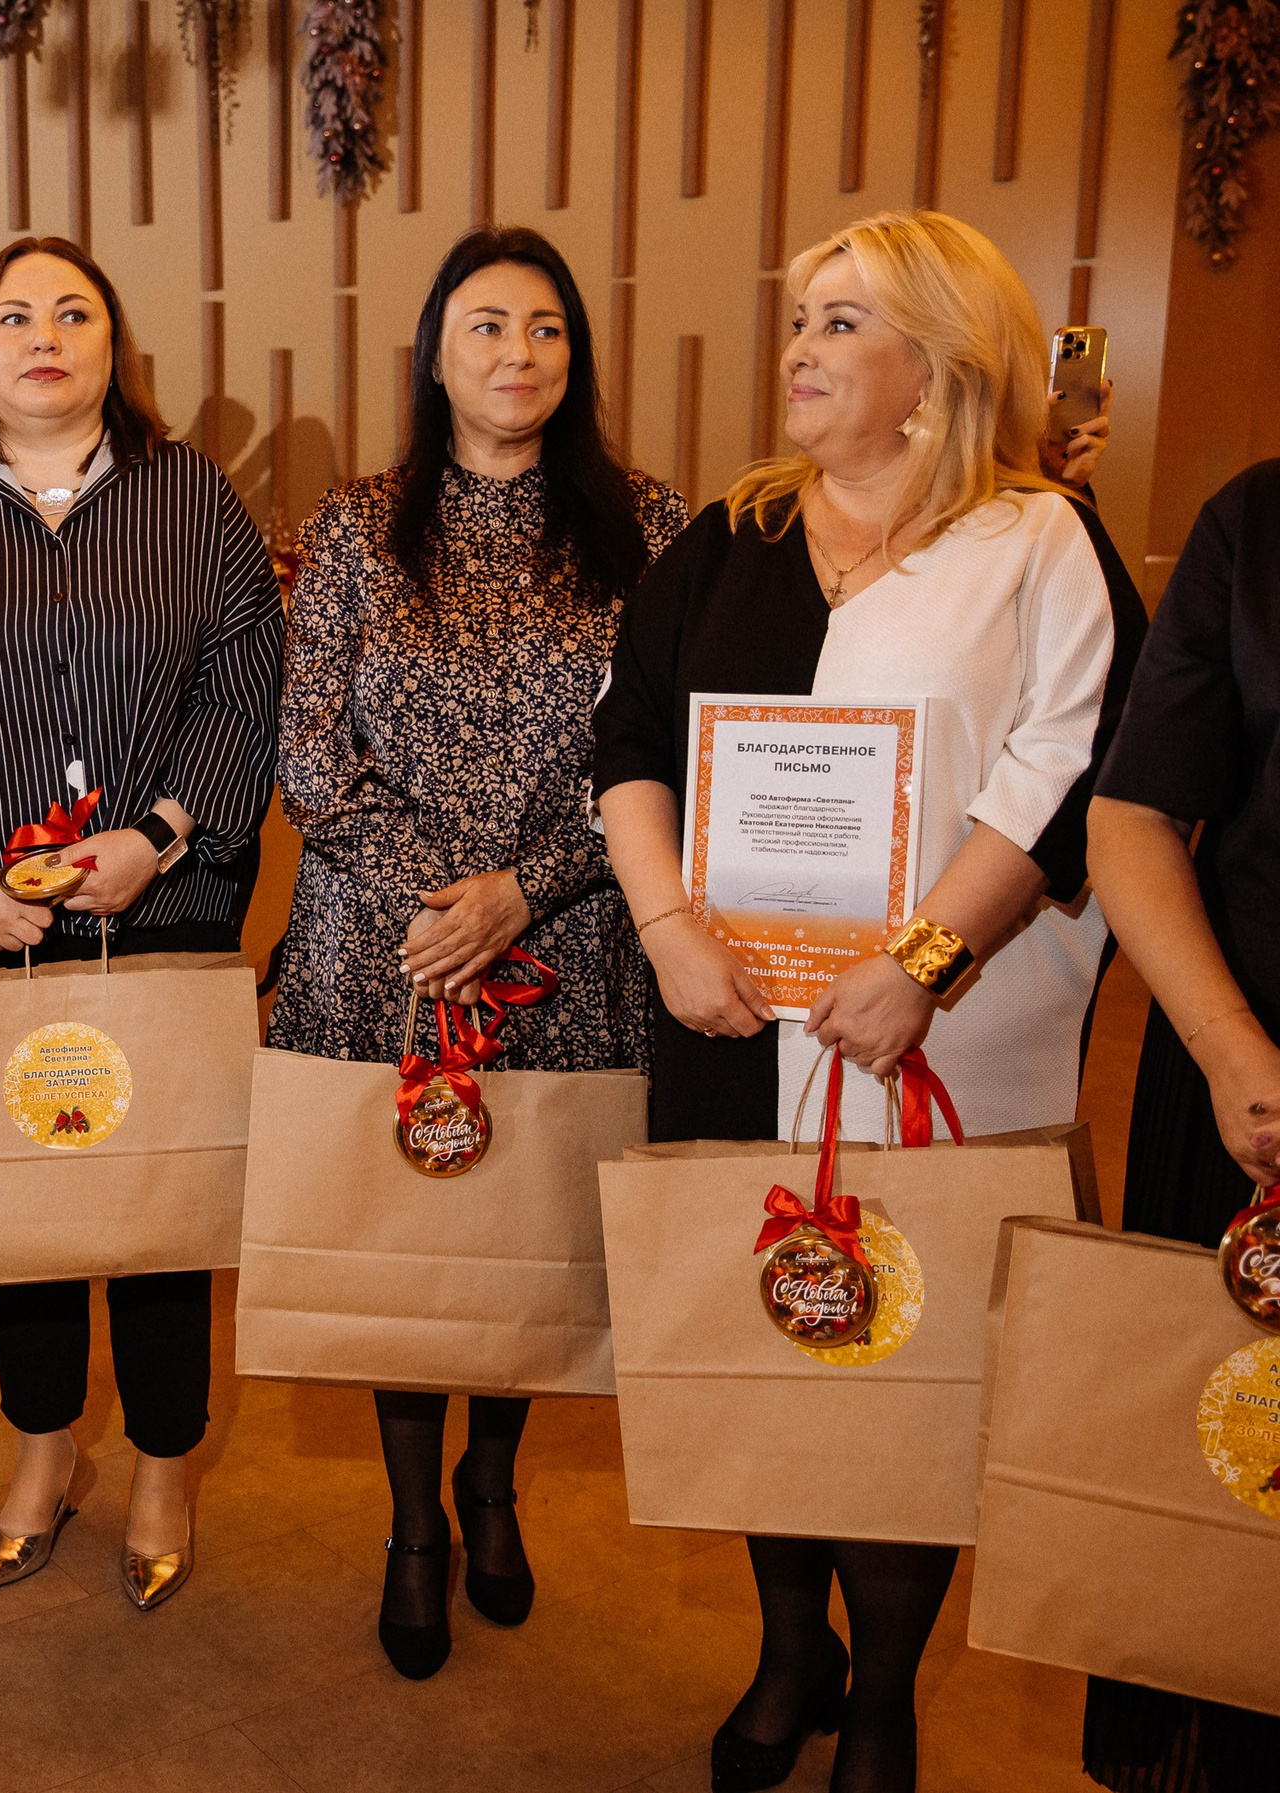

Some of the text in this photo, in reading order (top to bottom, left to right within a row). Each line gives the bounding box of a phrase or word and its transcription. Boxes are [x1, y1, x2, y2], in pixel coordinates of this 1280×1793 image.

[737, 743, 876, 757] БЛАГОДАРСТВЕННОЕ
[774, 762, 831, 773] ПИСЬМО
[768, 795, 811, 803] Автофирма
[742, 811, 791, 819] Руководителю
[817, 815, 862, 823] оформления
[775, 820, 814, 829] Екатерине
[815, 823, 861, 831] Николаевне
[751, 846, 797, 854] стабильность
[727, 938, 860, 957] Автофирма «Светлана»
[769, 955, 814, 968] 30 лет
[743, 966, 839, 982] пешной рабо
[39, 1045, 92, 1055] Автофирма
[23, 1067, 111, 1080] БЛАГОДАРНОСТЬ
[45, 1078, 90, 1087] ЗА ТРУД!
[41, 1092, 62, 1101] ЛЕТ
[64, 1090, 108, 1100] УСПЕХА!
[788, 1273, 857, 1302] Новым
[1237, 1425, 1280, 1443] 30 ЛЕ
